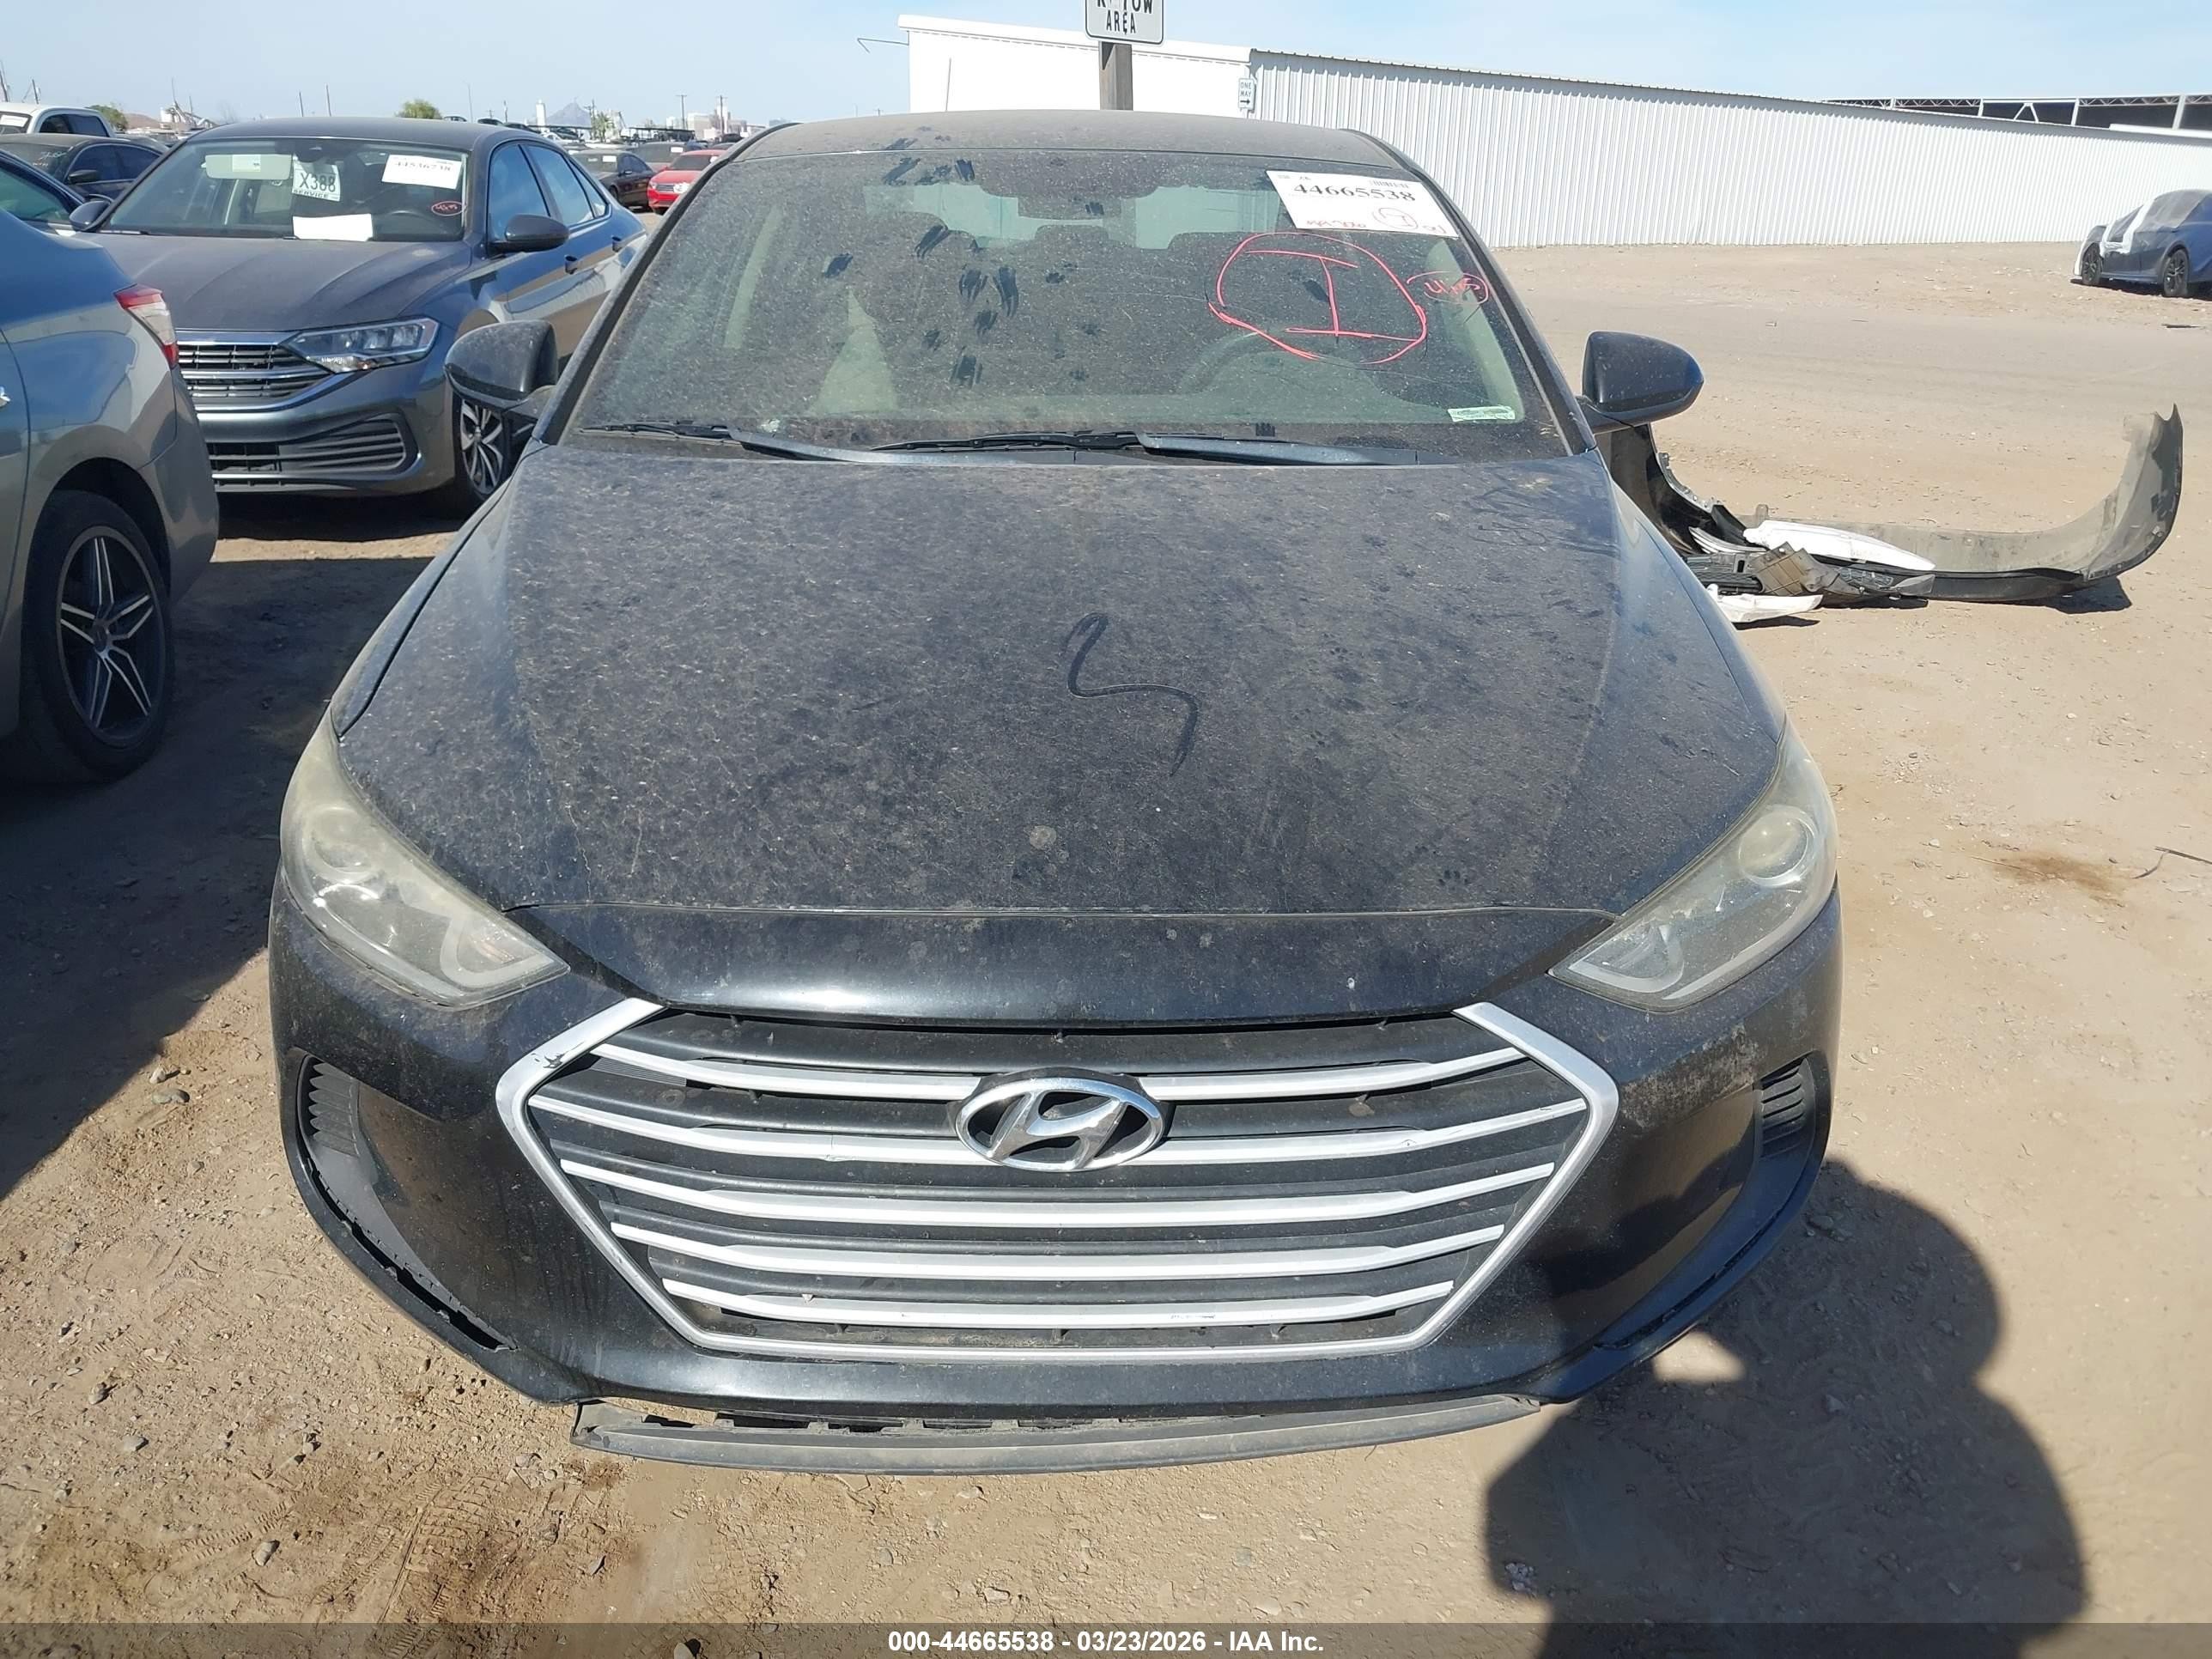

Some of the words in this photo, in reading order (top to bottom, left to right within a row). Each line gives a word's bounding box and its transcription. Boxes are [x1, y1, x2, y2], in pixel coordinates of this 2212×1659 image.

[1106, 9, 1136, 33] AREA
[300, 173, 336, 192] X388
[1294, 183, 1416, 202] 44665538
